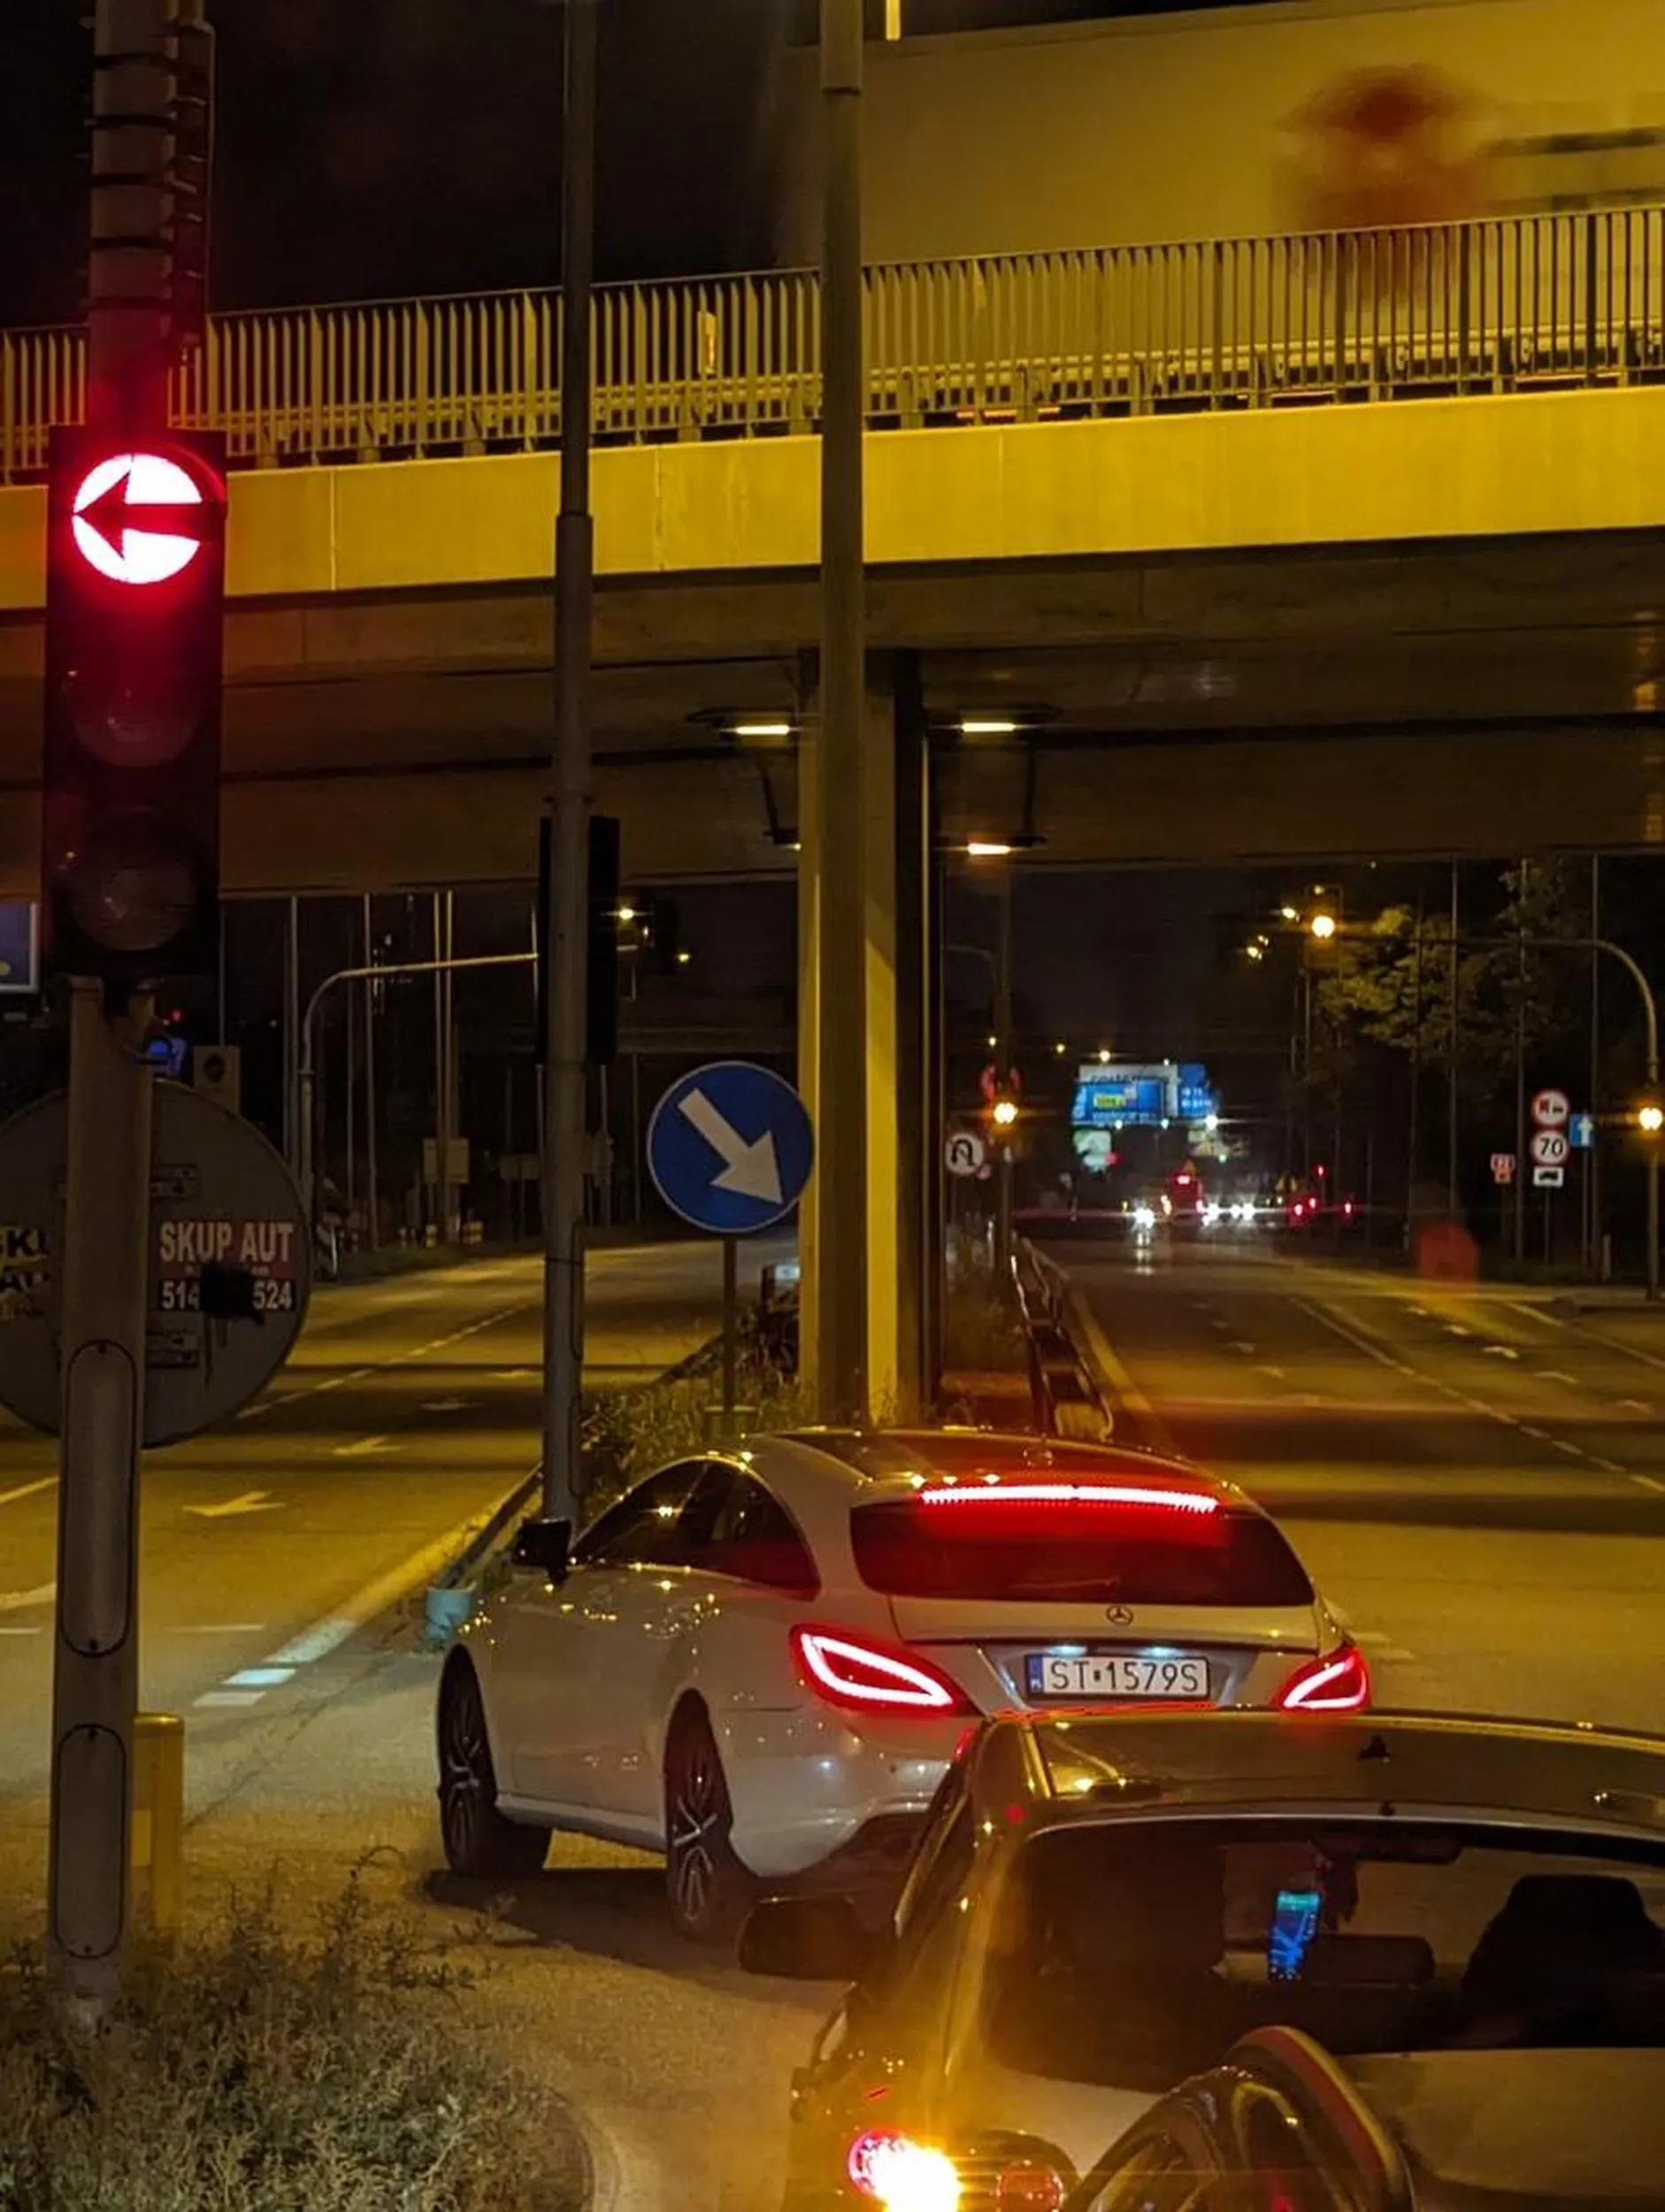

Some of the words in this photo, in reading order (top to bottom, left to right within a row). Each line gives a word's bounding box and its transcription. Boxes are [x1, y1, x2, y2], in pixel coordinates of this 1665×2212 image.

[1539, 1138, 1563, 1156] 70
[159, 1221, 232, 1263] SKUP
[239, 1221, 295, 1263] AUT
[1050, 1661, 1089, 1690] ST
[1106, 1662, 1198, 1692] 1579S
